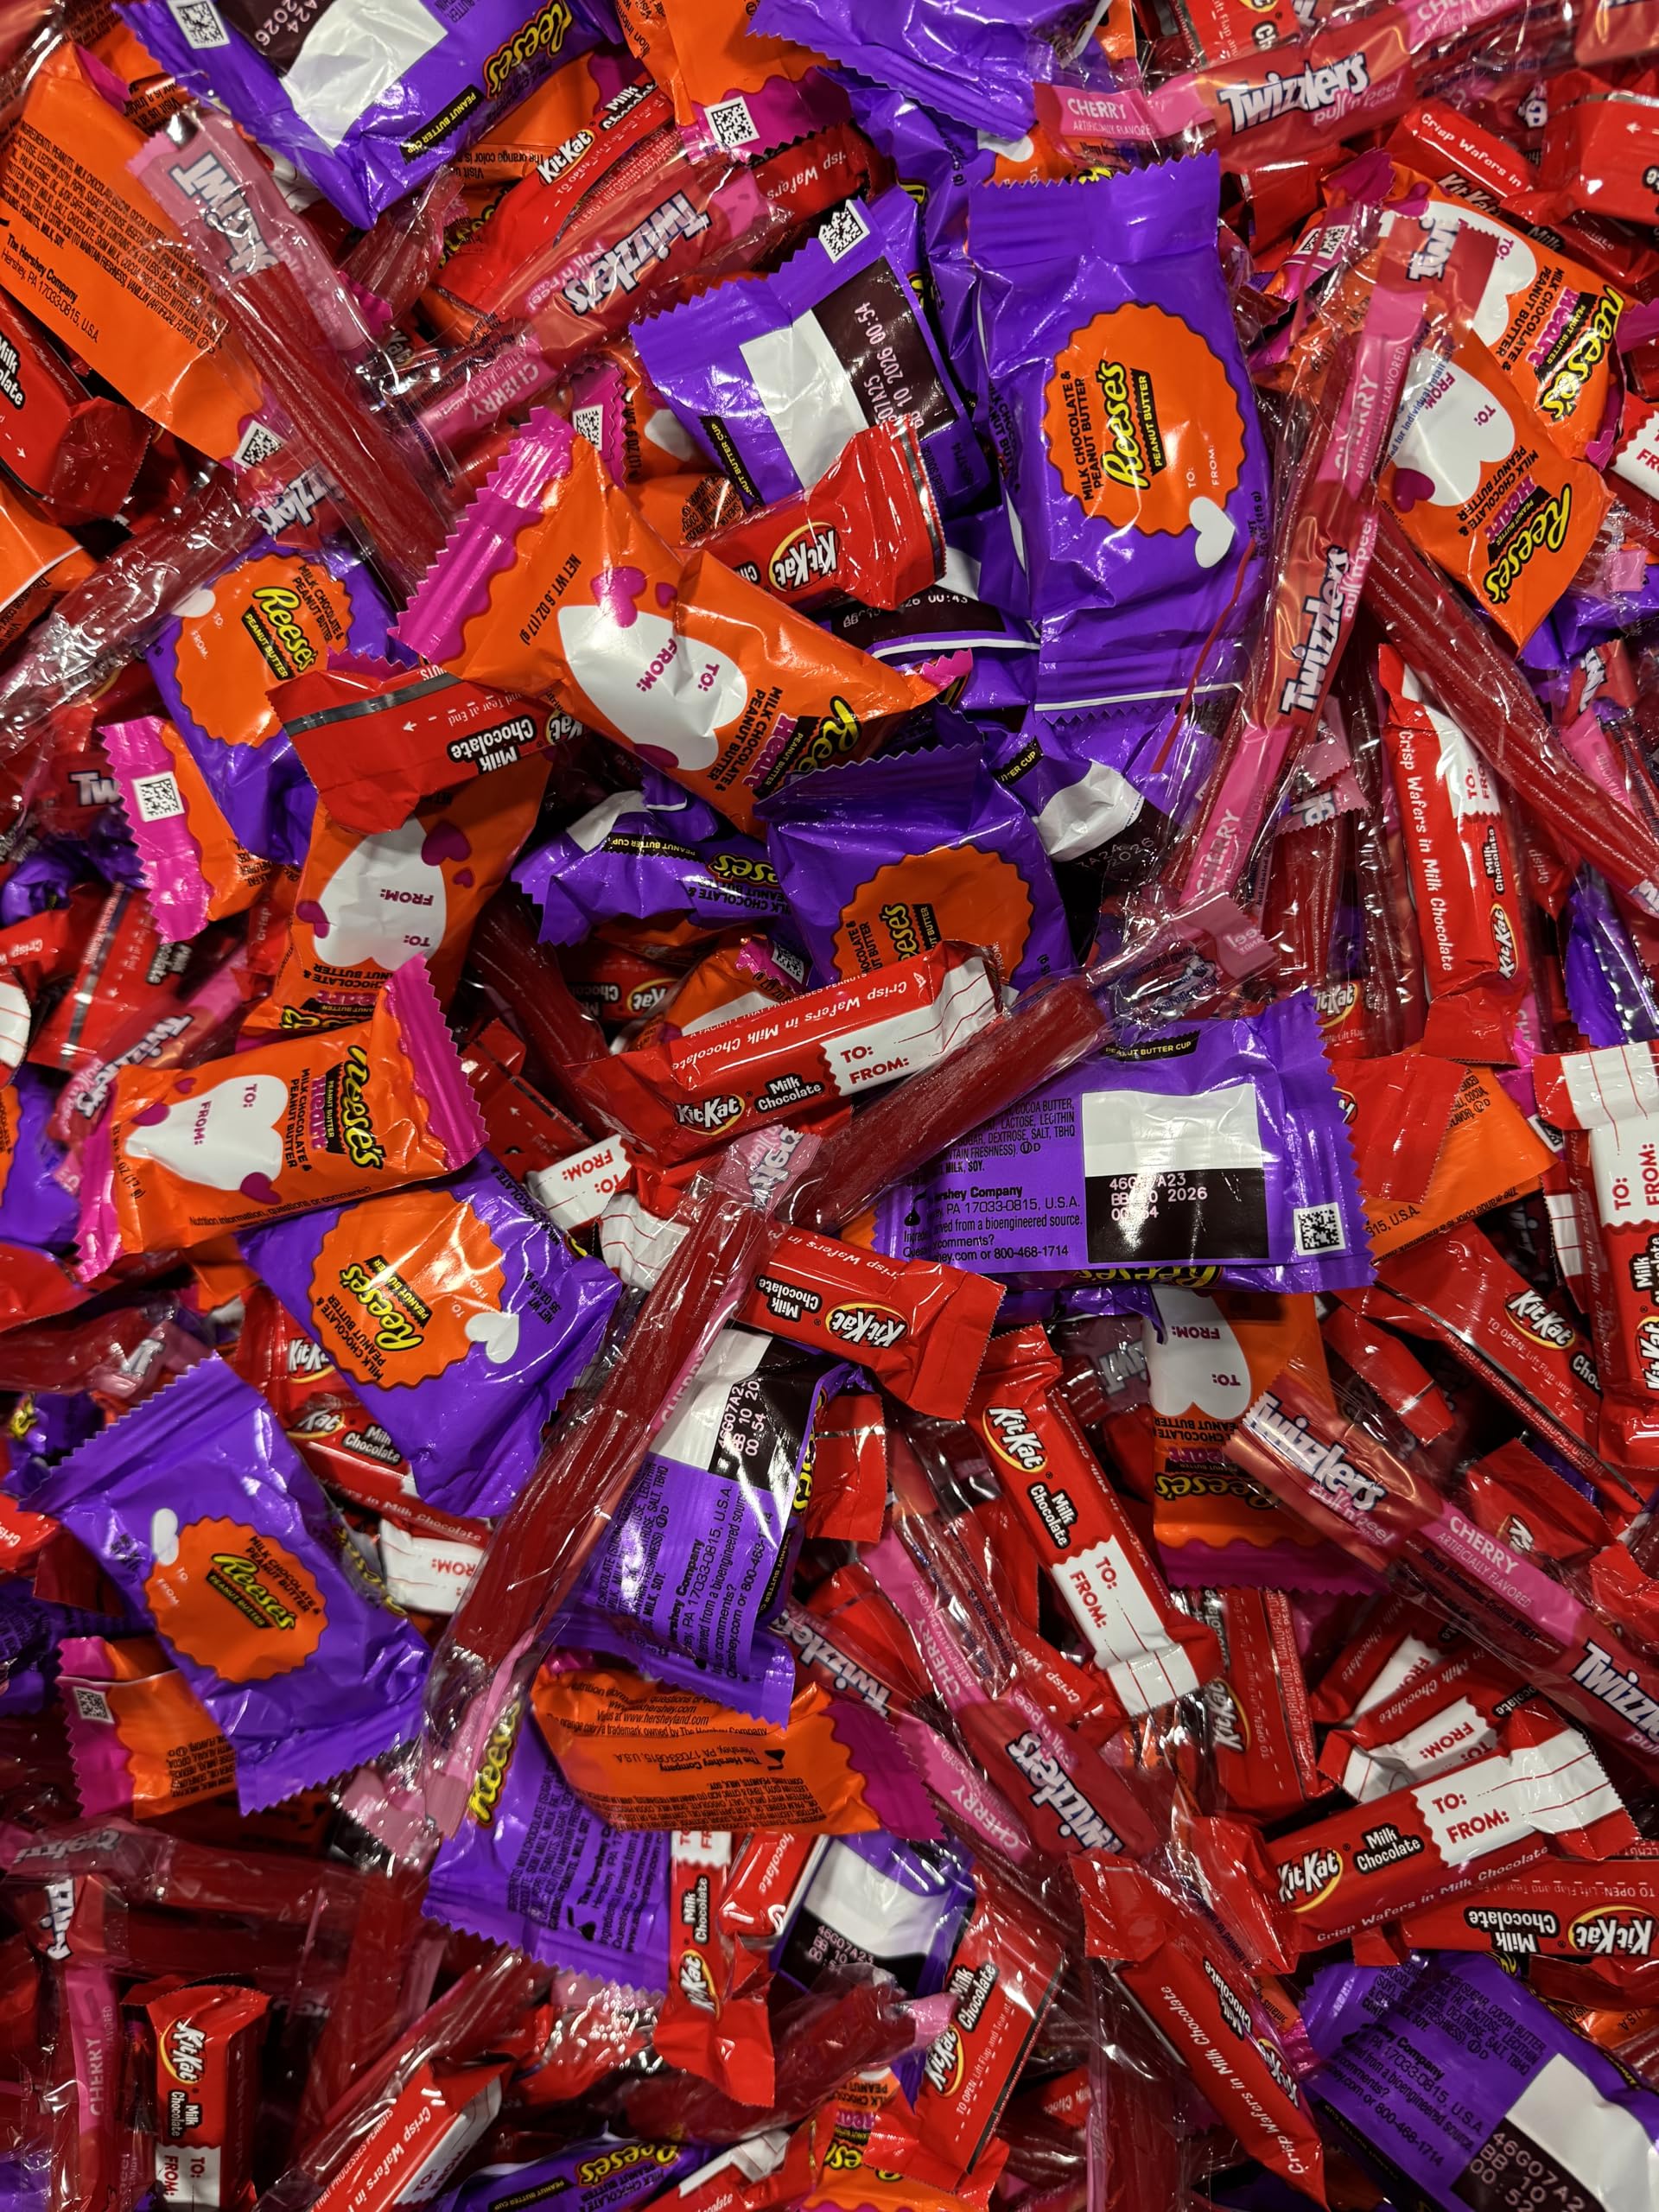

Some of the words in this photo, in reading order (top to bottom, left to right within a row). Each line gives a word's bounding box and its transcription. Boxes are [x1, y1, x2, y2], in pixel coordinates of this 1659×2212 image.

[607, 86, 639, 111] Milk
[1067, 98, 1125, 120] CHERRY
[1217, 52, 1370, 134] Twizzlers
[537, 130, 592, 184] KitKat
[1421, 112, 1456, 142] Crisp
[1459, 137, 1510, 177] Wafers
[7, 233, 19, 250] The
[20, 244, 46, 276] Hershey
[46, 269, 78, 303] Company
[1498, 238, 1515, 261] TO:
[28, 276, 37, 287] PA
[855, 302, 887, 345] 00:54
[877, 346, 903, 384] 2026
[1541, 286, 1625, 421] Reese's
[1383, 346, 1406, 404] FLAVORED
[1076, 378, 1093, 434] BUTTER
[1138, 375, 1151, 421] BUTTER
[1472, 404, 1496, 427] TO:
[1065, 385, 1088, 473] CHOCOLATE
[1096, 359, 1150, 490] Reese's
[1087, 435, 1103, 489] PEANUT
[1146, 422, 1162, 467] PEANUT
[1185, 467, 1195, 489] TO:
[1208, 446, 1220, 486] FROM:
[1078, 474, 1095, 500] MILK
[773, 529, 837, 584] KitKat
[1485, 484, 1572, 604] Reese's
[563, 553, 582, 579] NET
[253, 585, 317, 674] Reese's
[536, 602, 550, 620] OZ
[636, 639, 677, 692] FROM:
[698, 664, 720, 691] TO:
[735, 689, 766, 743] PEANUT
[760, 687, 783, 721] MILK
[452, 719, 534, 760] Chocolate
[727, 721, 767, 785] CHOCOLATE
[1398, 729, 1414, 771] Crisp
[479, 747, 518, 773] Milk
[707, 741, 742, 780] BUTTER
[1018, 750, 1037, 771] CUP
[1465, 767, 1476, 798] TO:
[1404, 775, 1429, 834] Wafers
[1419, 838, 1432, 854] in
[1485, 842, 1497, 875] Milk
[1492, 828, 1504, 893] Chocolate
[1423, 858, 1440, 893] Milk
[380, 888, 434, 906] FROM:
[404, 934, 429, 946] TO:
[1429, 898, 1452, 971] Chocolate
[1497, 906, 1515, 979] KitKat
[804, 998, 861, 1021] Wafers
[867, 981, 907, 1001] Crisp
[747, 1025, 779, 1046] Milk
[785, 1020, 799, 1030] in
[671, 1039, 741, 1071] Chocolate
[840, 1047, 874, 1063] TO:
[1141, 1042, 1171, 1056] BUTTER
[1173, 1039, 1192, 1052] CUP
[770, 1076, 800, 1095] Milk
[849, 1057, 910, 1084] FROM:
[243, 1083, 257, 1109] TO:
[289, 1079, 299, 1118] PEANUT
[342, 1046, 383, 1170] Reese's
[677, 1096, 741, 1127] KitKat
[758, 1084, 821, 1110] Chocolate
[1016, 1102, 1042, 1114] COCOA
[1043, 1098, 1074, 1112] BUTTER,
[194, 1099, 211, 1147] FROM:
[297, 1094, 309, 1163] CHOCOLATE
[987, 1130, 1029, 1143] DEXTROSE,
[1031, 1128, 1052, 1140] SALT,
[1055, 1126, 1075, 1137] TBHQ
[1001, 1116, 1038, 1128] LACTOSE,
[1039, 1112, 1074, 1125] LECITHIN
[287, 1120, 297, 1168] BUTTER
[563, 1152, 613, 1180] FROM:
[1638, 1143, 1658, 1206] FROM:
[947, 1203, 961, 1214] PA
[1046, 1195, 1080, 1209] U.S.A.
[970, 1185, 1022, 1198] Company
[1168, 1187, 1207, 1202] 2026
[1611, 1177, 1630, 1211] TO:
[955, 1219, 975, 1230] from
[986, 1215, 1047, 1230] bioengineered
[1050, 1212, 1083, 1226] source.
[805, 1243, 862, 1267] Wafers
[938, 1234, 995, 1247] comments?
[980, 1249, 990, 1259] or
[994, 1245, 1069, 1259] 800-468-1714
[1633, 1254, 1652, 1288] Milk
[340, 1262, 424, 1351] Reese's
[759, 1279, 819, 1311] Chocolate
[771, 1299, 800, 1319] Milk
[831, 1310, 908, 1348] KitKat
[1171, 1326, 1220, 1338] FROM:
[1488, 1318, 1499, 1330] TO
[1500, 1329, 1526, 1351] OPEN:
[1509, 1291, 1575, 1348] KitKat
[1211, 1374, 1241, 1386] TO:
[344, 1433, 400, 1465] Chocolate
[988, 1408, 1046, 1471] KitKat
[1243, 1392, 1389, 1511] Twizzlers
[1030, 1484, 1070, 1548] Chocolate
[1056, 1491, 1076, 1526] Milk
[683, 1613, 695, 1628] PA
[713, 1486, 732, 1522] U.S.A.
[715, 1523, 740, 1590] bioengineered
[1449, 1516, 1519, 1574] CHERRY
[677, 1539, 704, 1596] Company
[1096, 1557, 1117, 1591] TO:
[212, 1554, 296, 1630] Reese's
[1070, 1568, 1107, 1630] FROM:
[914, 1618, 963, 1698] CHERRY
[1420, 1722, 1475, 1760] FROM:
[951, 1787, 1020, 1852] CHERRY
[1432, 1793, 1467, 1814] TO:
[1366, 1827, 1397, 1849] Milk
[1446, 1809, 1510, 1844] FROM:
[1356, 1838, 1421, 1872] Chocolate
[1278, 1853, 1338, 1903] KitKat
[1317, 1923, 1356, 1942] Crisp
[1361, 1903, 1416, 1927] Wafers
[1440, 1879, 1471, 1896] Milk
[1477, 1846, 1548, 1879] Chocolate
[682, 1891, 696, 1924] Milk
[695, 1876, 709, 1943] Chocolate
[1469, 1910, 1556, 1932] Chocolate
[1494, 1930, 1535, 1952] Milk
[1574, 1918, 1651, 1955] KitKat
[958, 1964, 996, 2030] Chocolate
[1160, 1986, 1211, 2045] Chocolate
[172, 2020, 206, 2083] KitKat
[1207, 2049, 1230, 2074] Milk
[1397, 2037, 1445, 2080] Company
[88, 2036, 103, 2116] CHERRY
[171, 2091, 181, 2137] Chocolate
[186, 2105, 199, 2129] Milk
[404, 2106, 431, 2145] Crisp
[957, 2101, 966, 2114] TO
[1241, 2092, 1278, 2131] Wafers
[191, 2157, 206, 2178] TO:
[366, 2141, 405, 2191] Wafers
[1277, 2134, 1306, 2175] Crisp
[163, 2155, 179, 2195] FROM:
